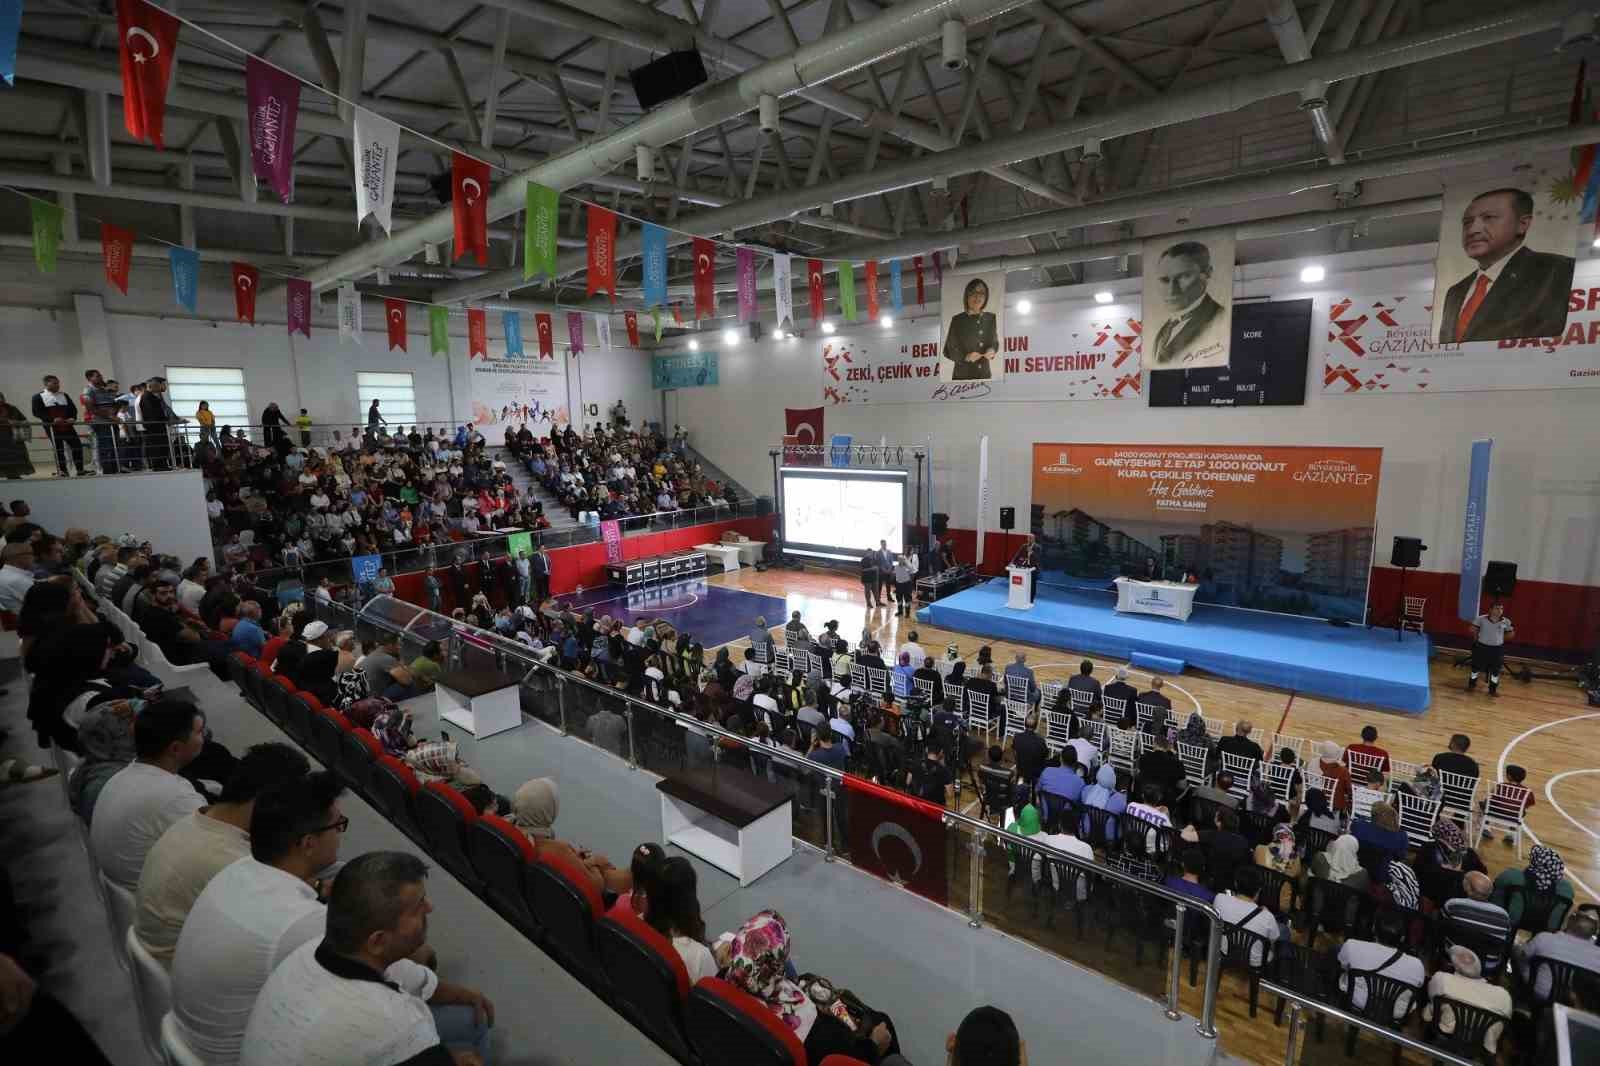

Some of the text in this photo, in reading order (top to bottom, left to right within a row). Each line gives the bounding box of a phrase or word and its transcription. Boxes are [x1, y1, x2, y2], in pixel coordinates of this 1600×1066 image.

[912, 343, 938, 358] BEN
[846, 363, 874, 382] ZEKİ,
[878, 361, 912, 383] ÇEVİK
[916, 366, 931, 377] ve
[1204, 453, 1263, 461] KAPSAMINDA
[1208, 461, 1239, 470] 1000
[1242, 462, 1288, 471] KONUT
[1118, 469, 1147, 479] KURA
[1156, 499, 1181, 507] FATMA
